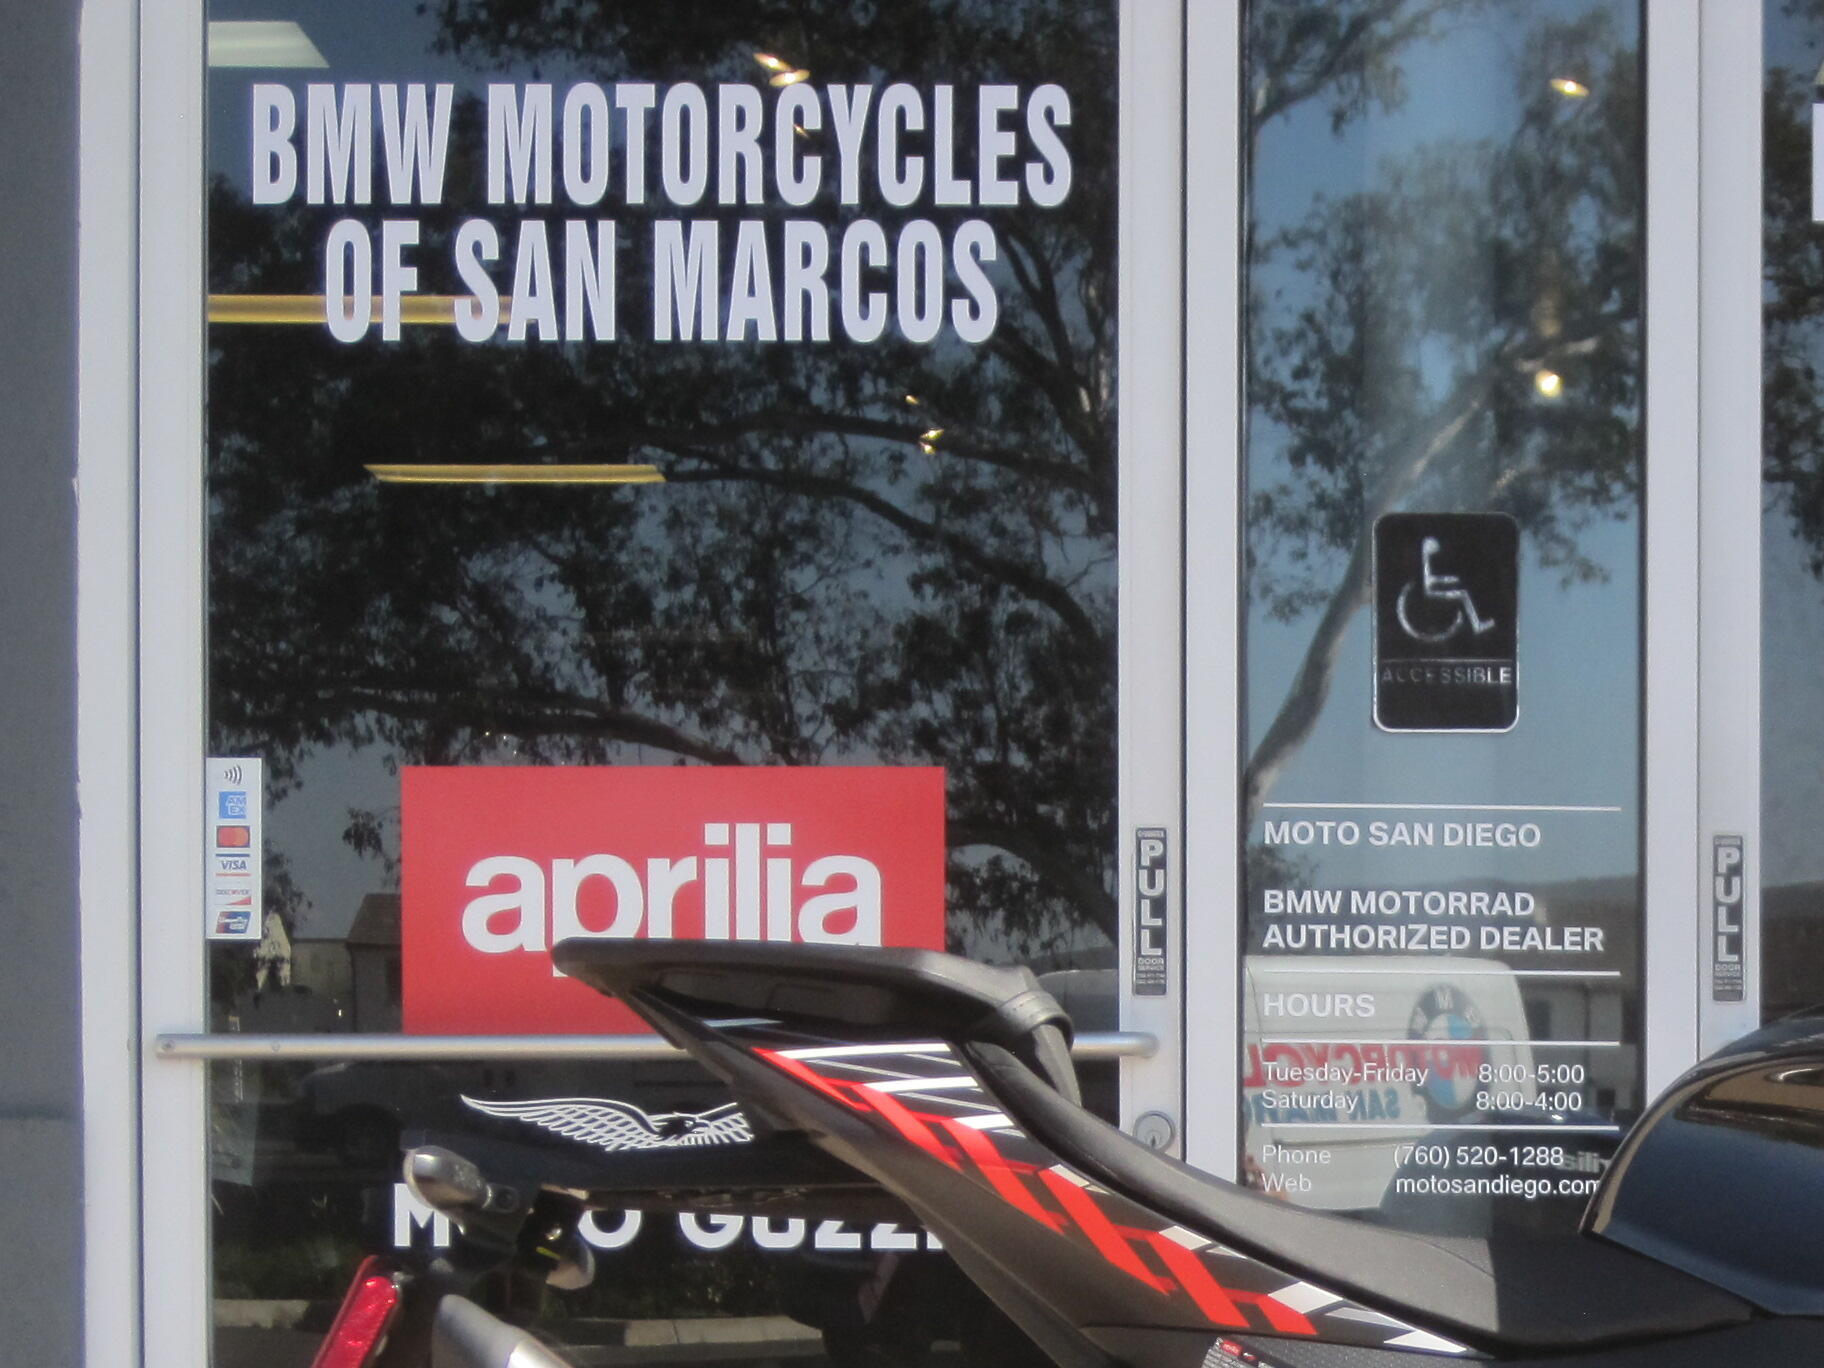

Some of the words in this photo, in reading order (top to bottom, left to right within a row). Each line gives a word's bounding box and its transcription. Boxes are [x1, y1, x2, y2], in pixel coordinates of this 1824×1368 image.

[252, 84, 454, 206] BMW
[487, 83, 1073, 208] MOTORCYCLES
[323, 219, 420, 344] OF
[453, 218, 617, 343] SAN
[653, 219, 999, 344] MARCOS
[1381, 666, 1513, 685] ACCESSIBLE
[1263, 820, 1361, 846] MOTO
[1368, 821, 1438, 848] SAN
[1443, 822, 1543, 848] DIEGO
[221, 860, 247, 870] VISA
[461, 822, 882, 978] aprilia
[1138, 839, 1165, 956] PULL
[1263, 889, 1343, 914] BMW
[1350, 890, 1537, 917] MOTORRAD
[1715, 846, 1741, 962] PULL
[1262, 923, 1472, 951] AUTHORIZED
[1480, 925, 1605, 953] DEALER
[1263, 993, 1376, 1019] HOURS
[1262, 1061, 1430, 1090] Tuesday-Friday
[1478, 1064, 1586, 1086] 8:00-5:00
[1262, 1089, 1360, 1117] Saturday
[1475, 1091, 1583, 1113] 8:00-4:00
[1262, 1145, 1332, 1166] Phone
[1393, 1145, 1450, 1170] (760)
[1455, 1146, 1565, 1167] 520-1288
[1261, 1174, 1313, 1194] Web
[1395, 1173, 1600, 1203] motosandiego.com
